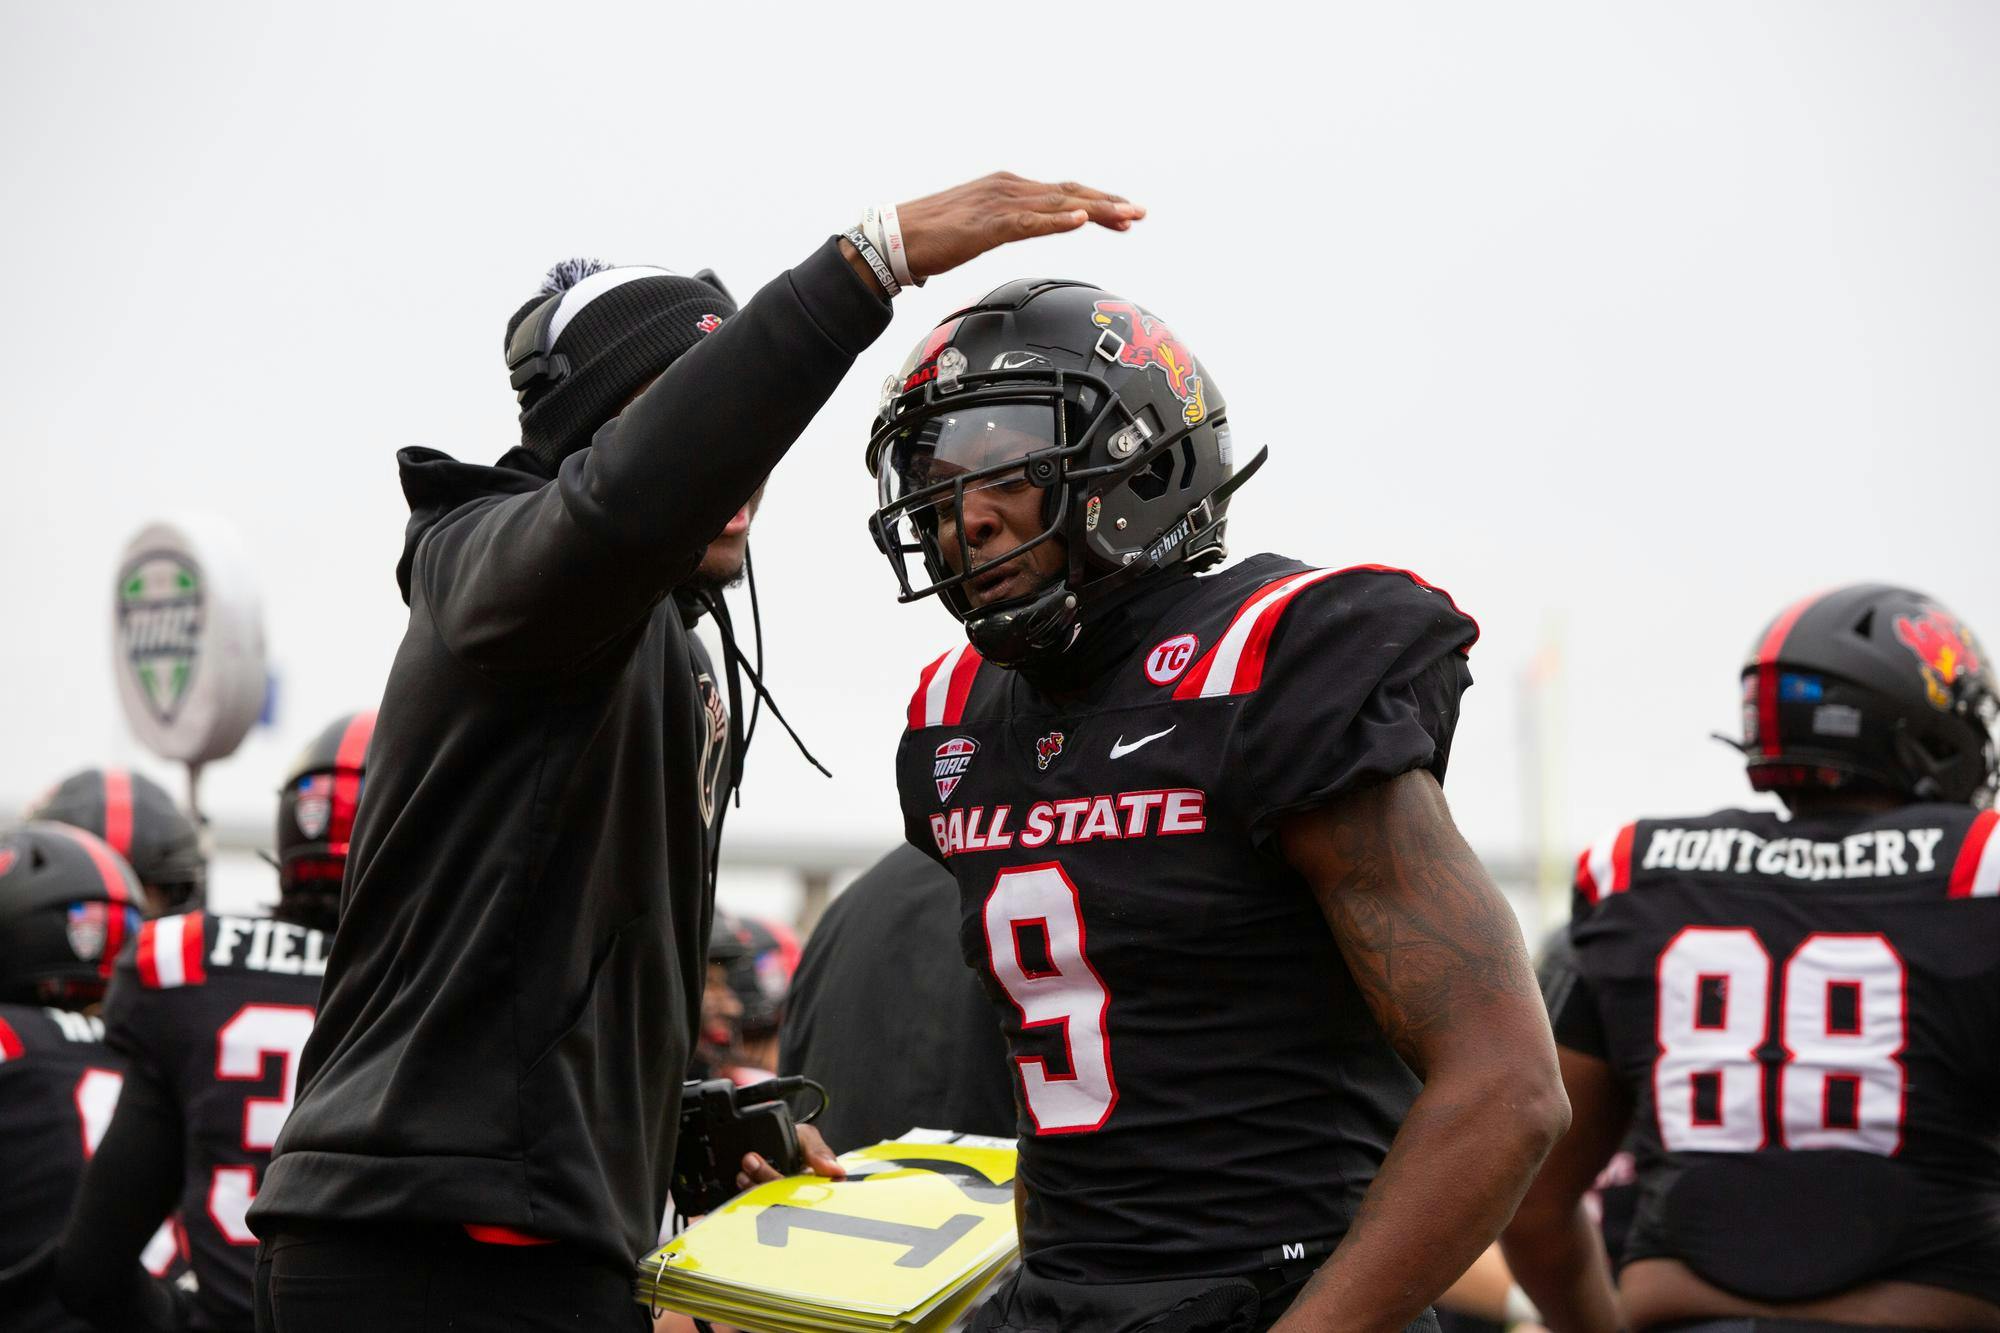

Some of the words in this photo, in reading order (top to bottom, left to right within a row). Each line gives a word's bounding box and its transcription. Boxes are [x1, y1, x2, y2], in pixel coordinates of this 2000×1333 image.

[863, 248, 892, 285] LIVES
[1154, 643, 1191, 672] TC
[933, 756, 971, 777] MAC
[929, 804, 1015, 858] BALL
[1019, 788, 1206, 849] STATE
[1643, 828, 1943, 881] MONTGOMERY
[982, 860, 1120, 1136] 9
[1653, 924, 1908, 1158] 88
[1282, 1242, 1305, 1260] M
